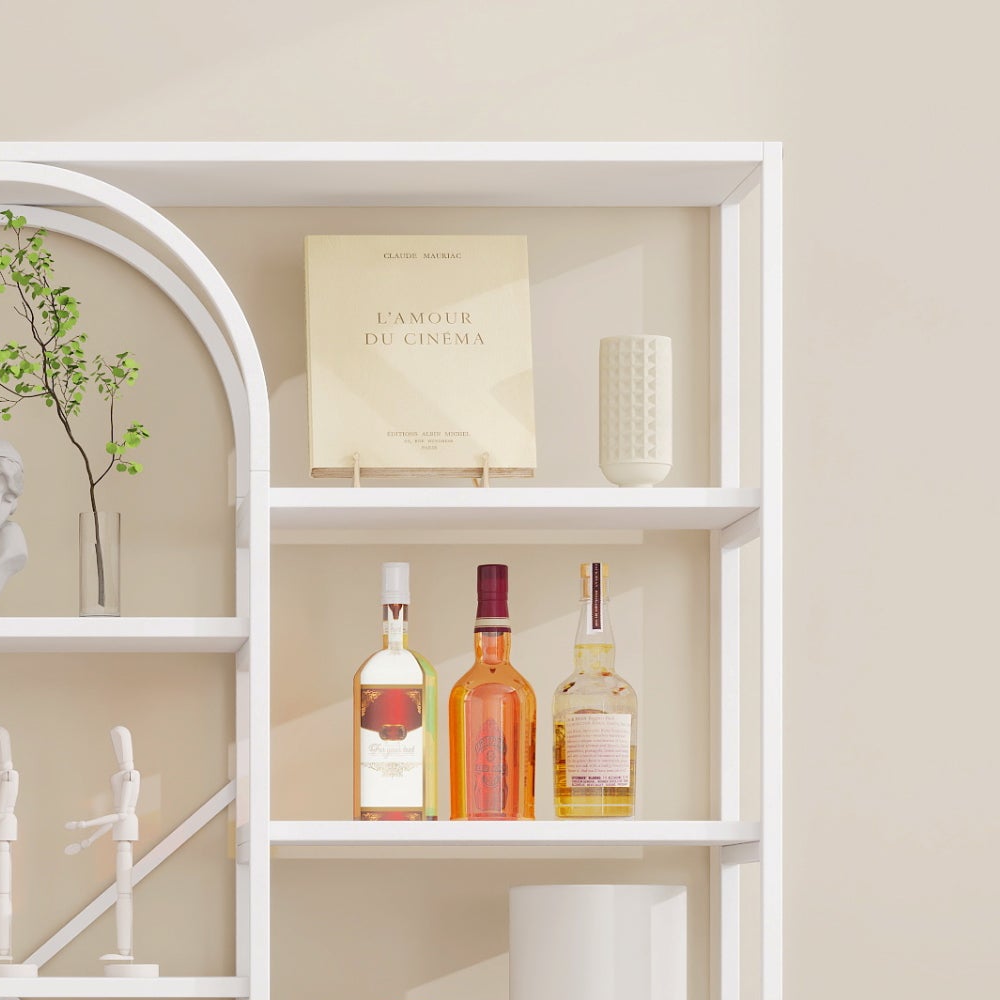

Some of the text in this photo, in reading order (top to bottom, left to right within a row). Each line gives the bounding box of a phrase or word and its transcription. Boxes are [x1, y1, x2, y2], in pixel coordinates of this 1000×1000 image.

[376, 311, 473, 325] L'AMOUR
[364, 331, 486, 346] DU CINÉMA
